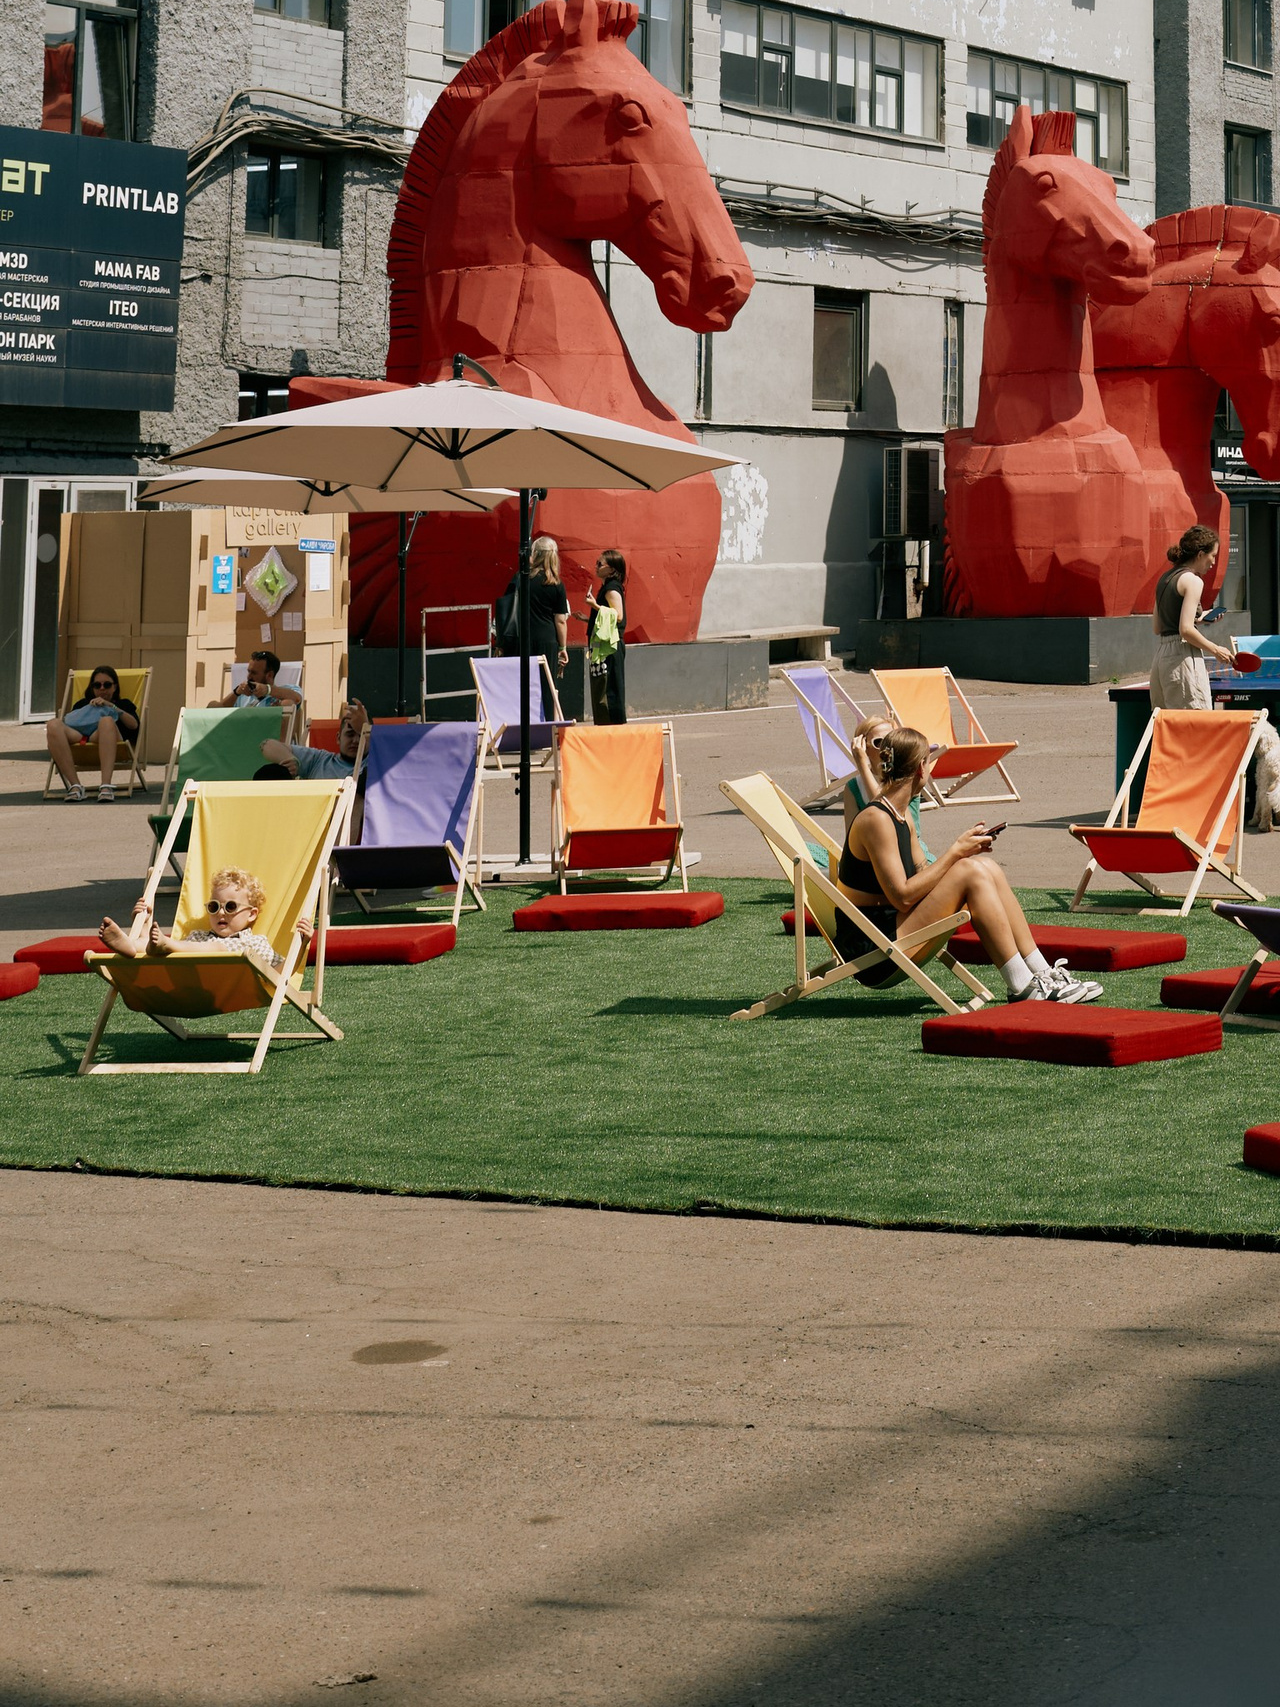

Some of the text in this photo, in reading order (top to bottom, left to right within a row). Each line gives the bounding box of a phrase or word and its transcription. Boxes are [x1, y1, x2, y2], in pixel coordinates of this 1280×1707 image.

[82, 182, 179, 214] PRINTLAB
[0, 209, 14, 222] ЕР
[94, 260, 160, 281] MANA FAB
[8, 272, 48, 284] МАСТЕРСКАЯ
[79, 280, 171, 294] СТУДИЯ ПРОМЫШЛЕННОГО ДИЗАЙНА
[4, 312, 41, 323] БАРАБАНОВ
[72, 318, 174, 333] МАСТЕРСКАЯ ИНТЕРАКТИВНЫХ РЕШЕНИЙ
[18, 333, 56, 350] ПАРК
[13, 352, 34, 362] МУЗЕЙ
[36, 354, 57, 363] НАУКИ
[244, 518, 302, 540] gallery
